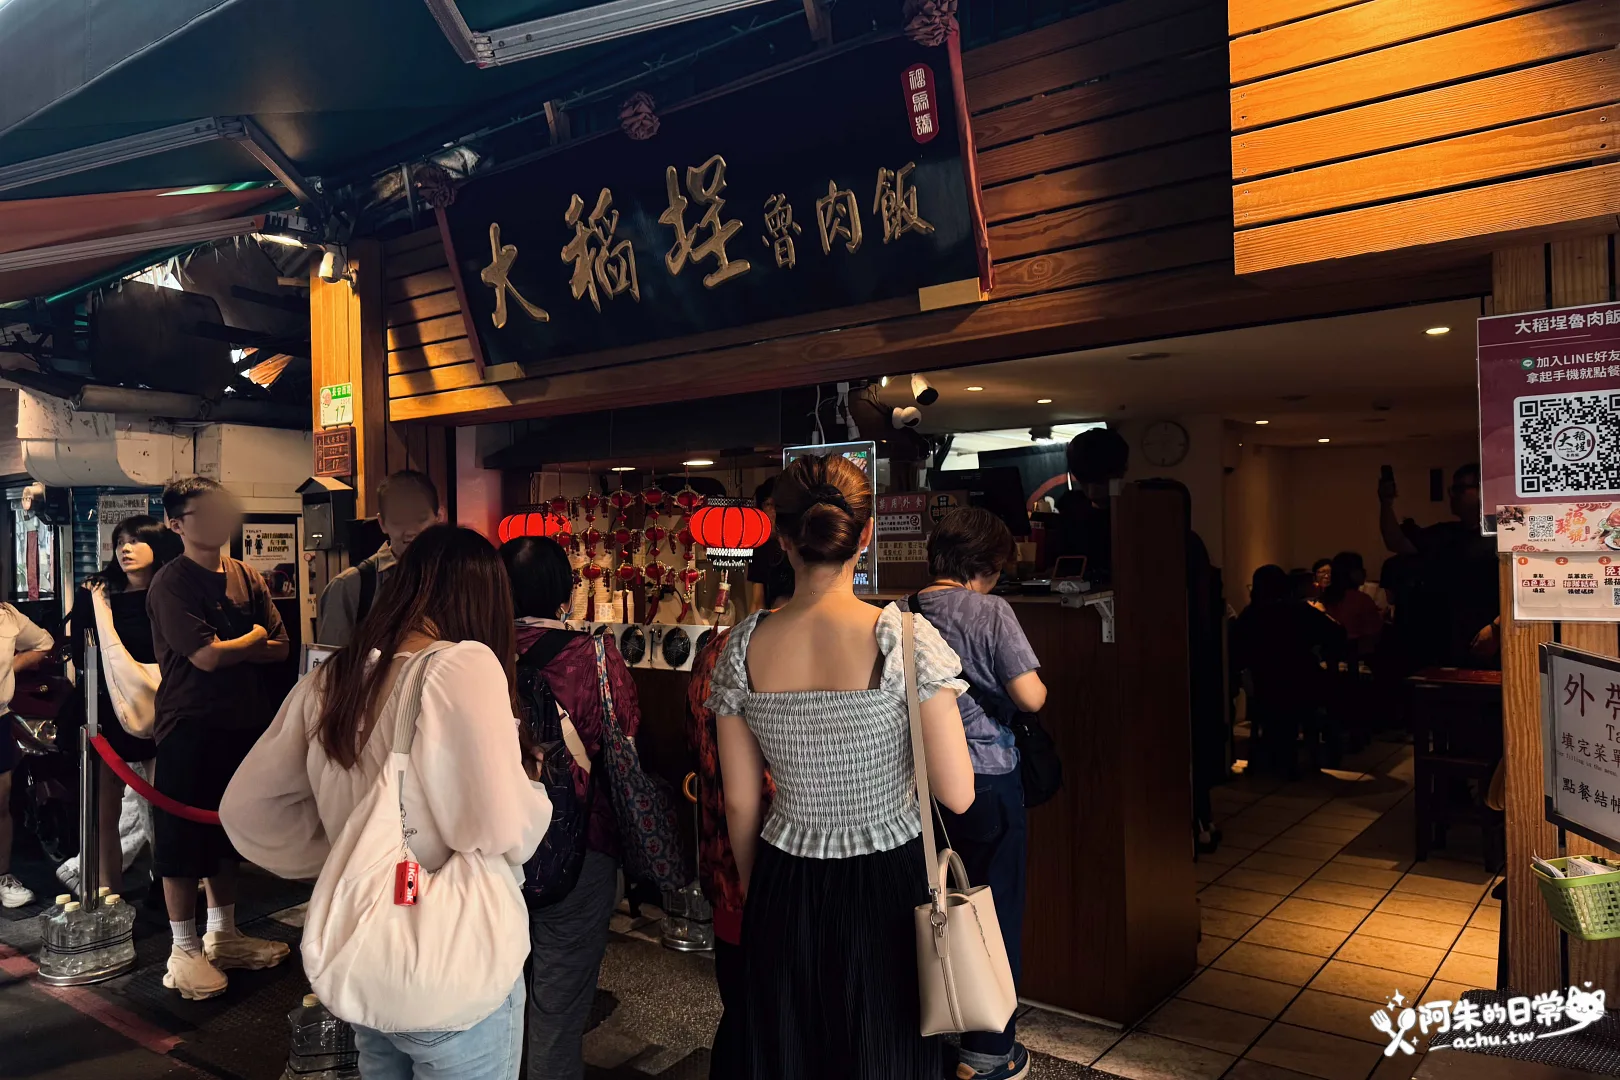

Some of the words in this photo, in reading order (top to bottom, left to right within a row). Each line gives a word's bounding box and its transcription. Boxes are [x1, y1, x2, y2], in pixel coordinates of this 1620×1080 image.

[480, 153, 936, 329] 大稻埕魯肉飯
[1514, 309, 1620, 335] 大稻埕魯肉飯
[1536, 349, 1620, 369] 加入LINE好友
[1526, 364, 1620, 384] 拿起手機就點餐
[335, 405, 346, 422] 17
[1605, 566, 1620, 576] 免
